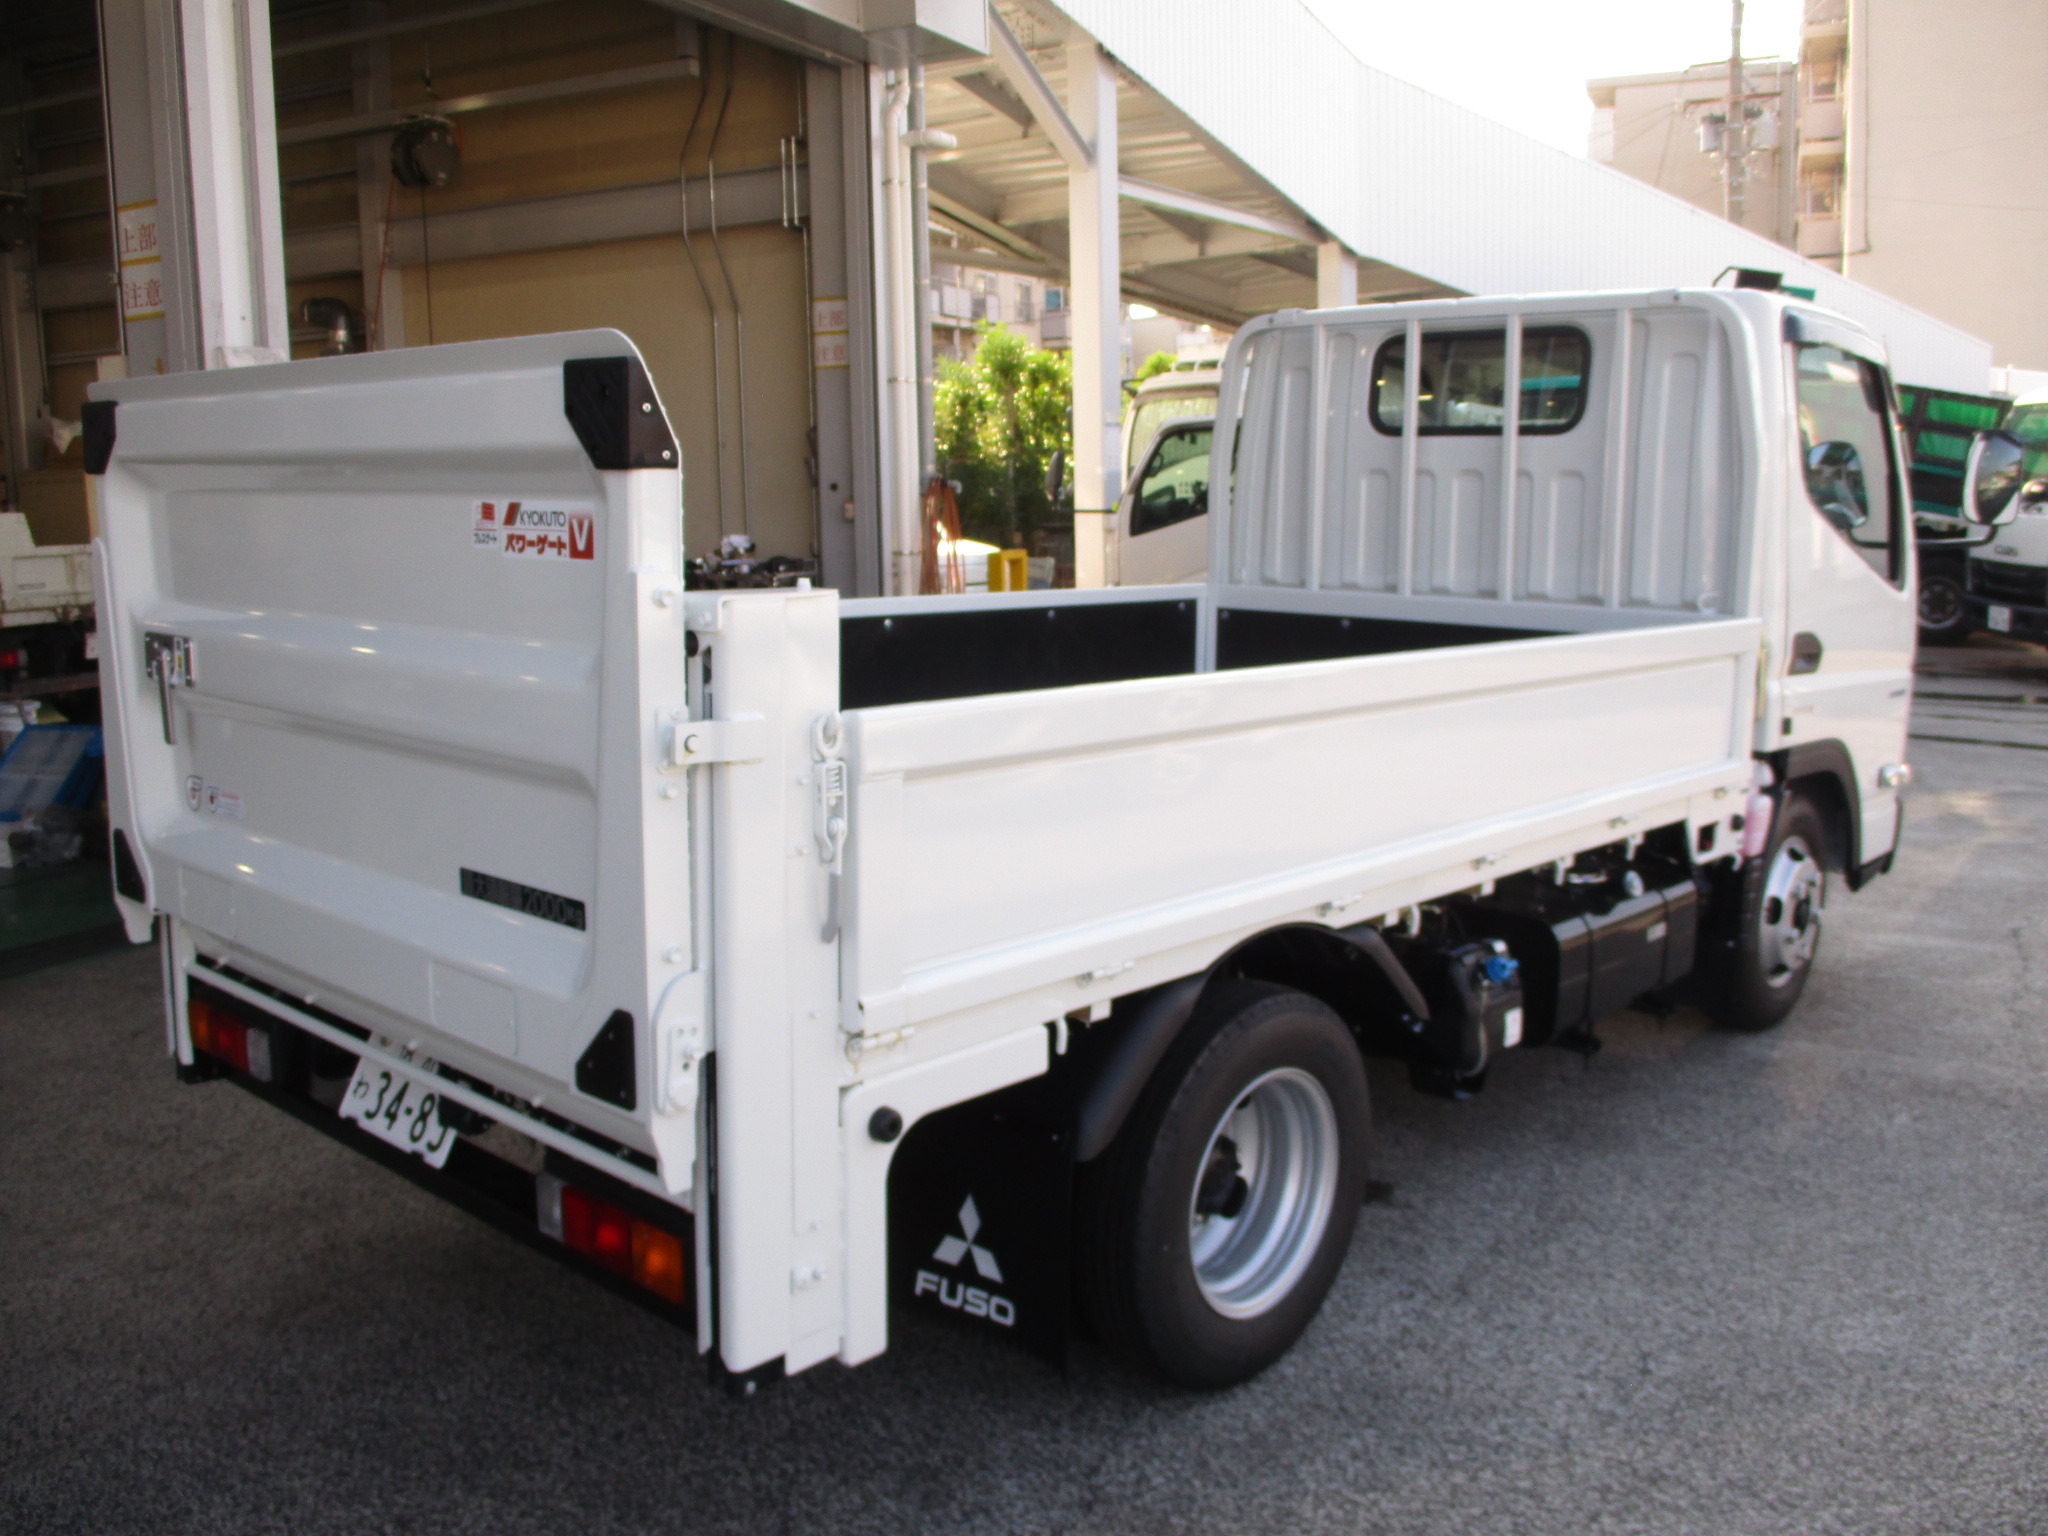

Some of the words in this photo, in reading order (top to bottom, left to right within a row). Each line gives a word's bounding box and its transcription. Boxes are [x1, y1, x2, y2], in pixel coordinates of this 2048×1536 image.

[121, 223, 157, 254] 上部
[124, 279, 162, 309] 注意
[519, 510, 567, 527] KYOKUTO
[505, 533, 567, 556] パワーゲート
[571, 518, 591, 552] V
[914, 1269, 1016, 1327] FUSO
